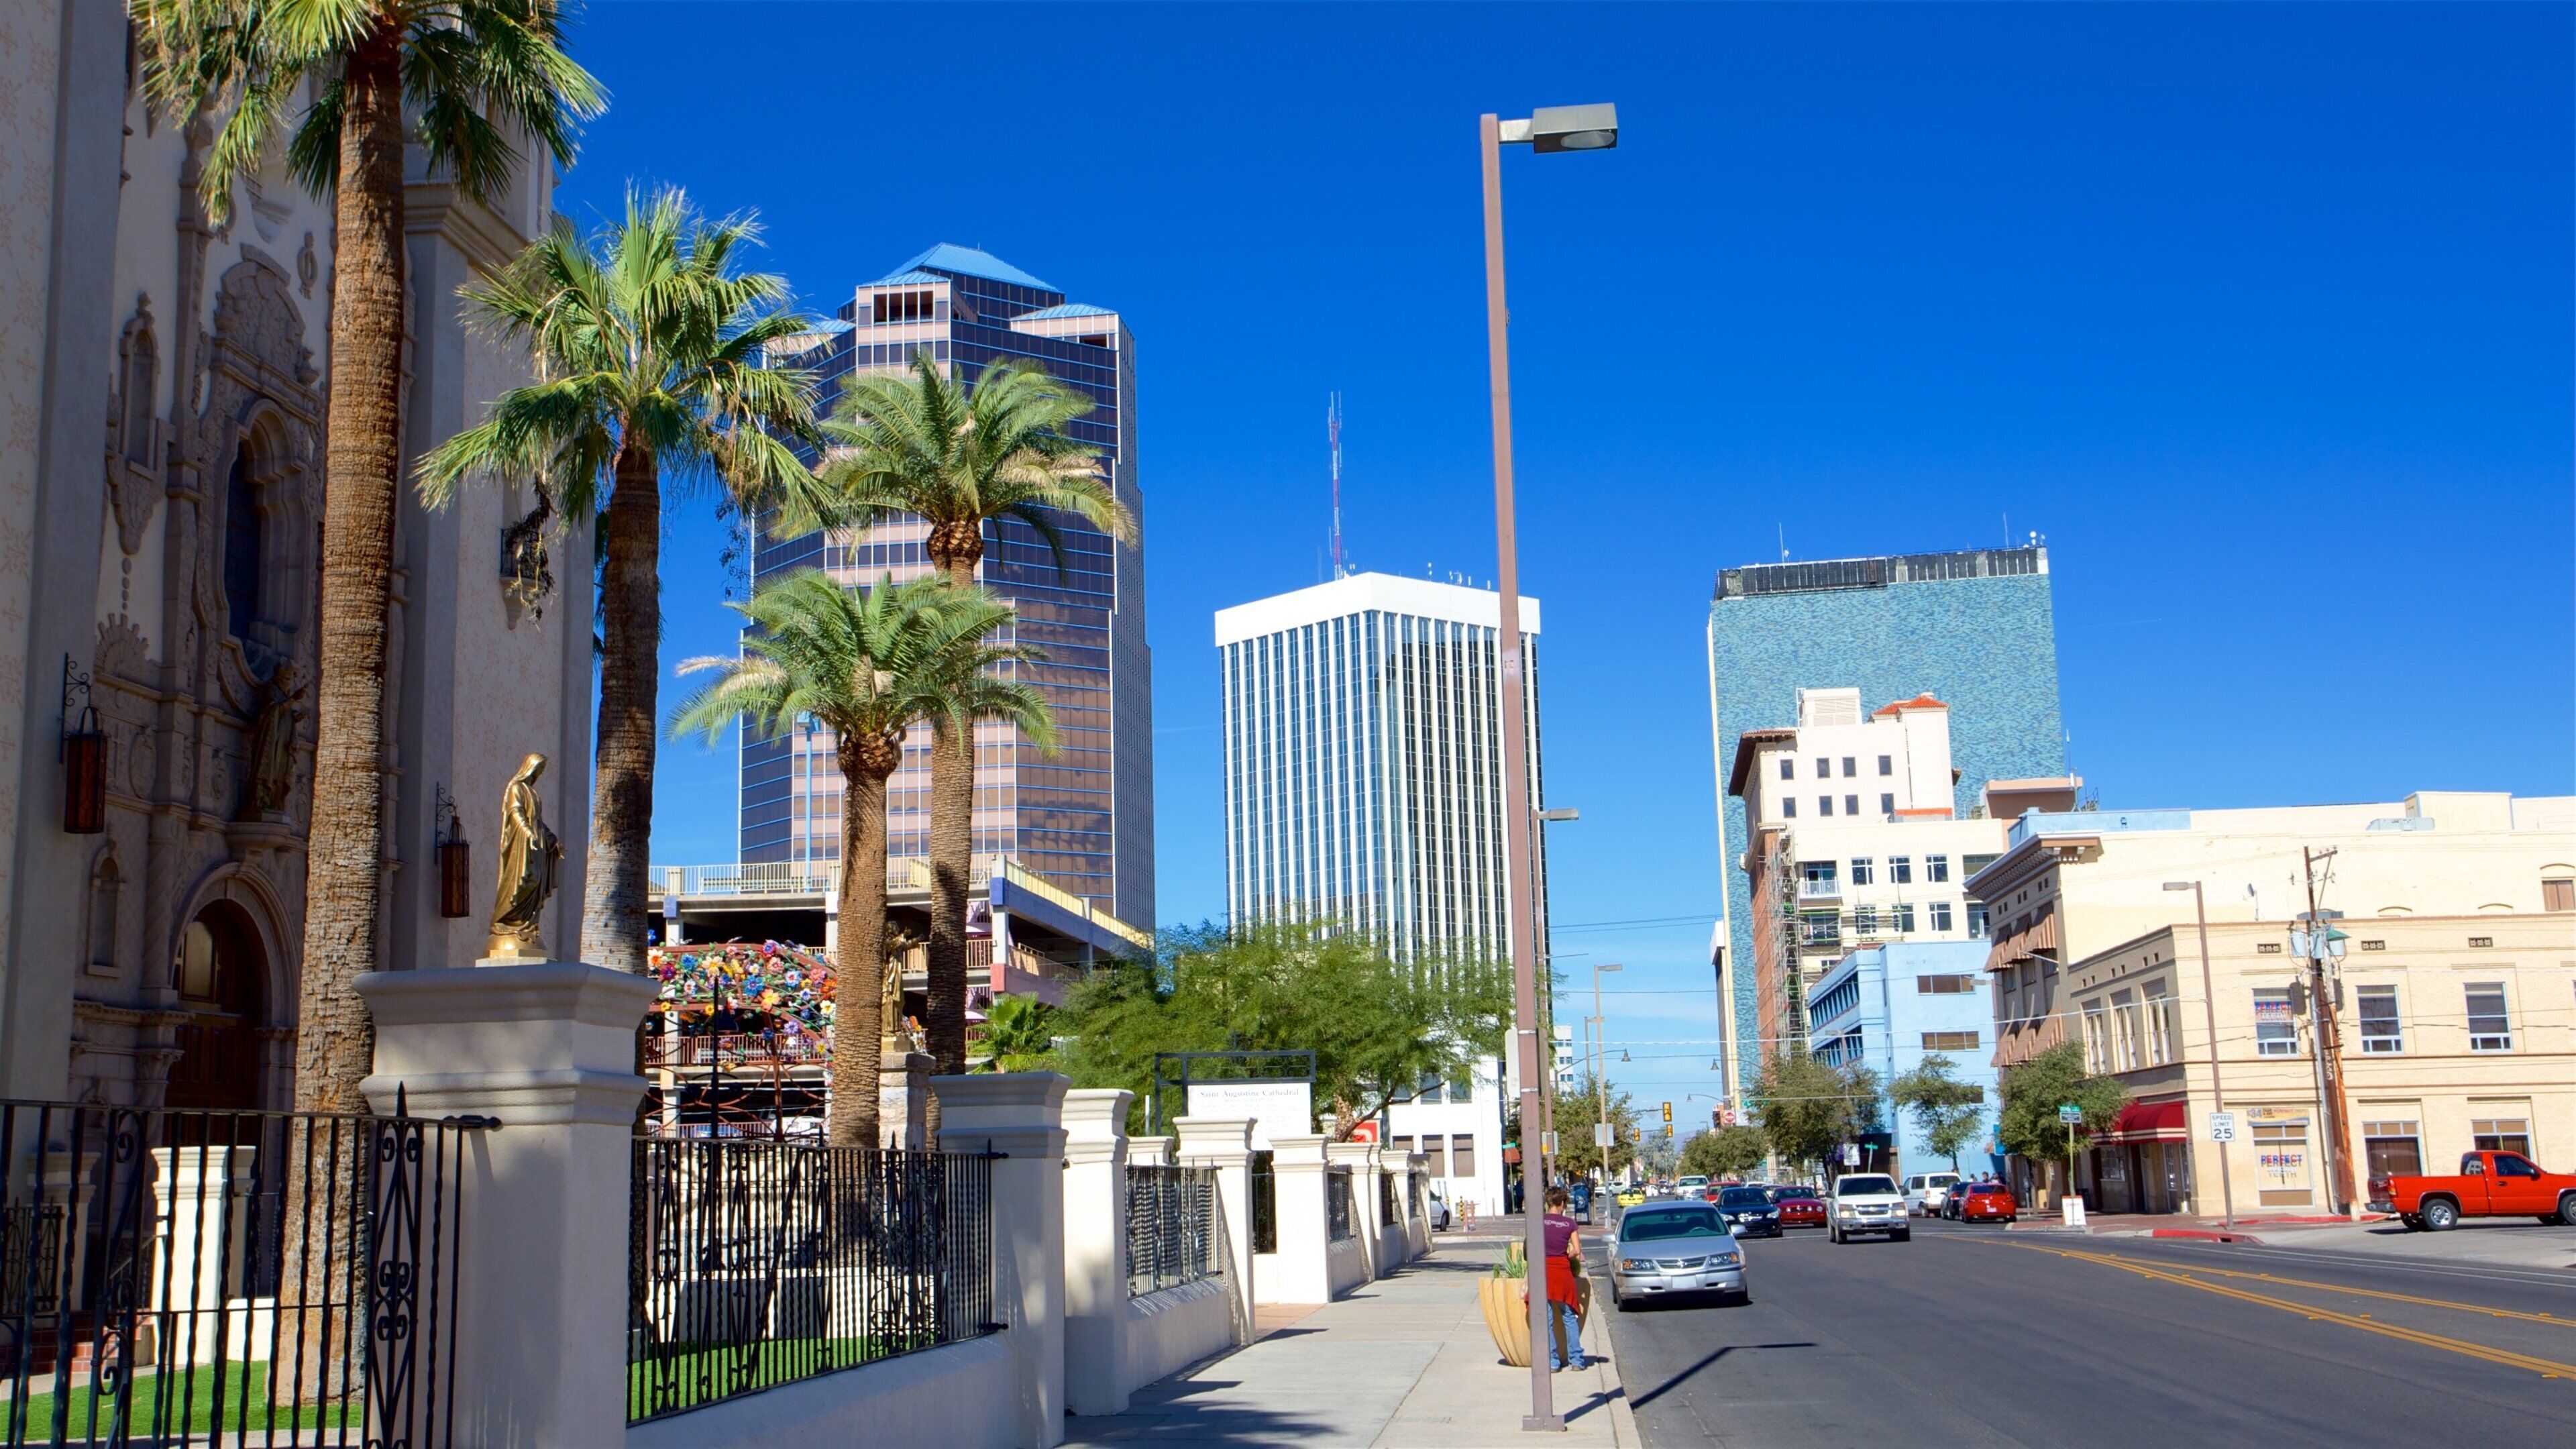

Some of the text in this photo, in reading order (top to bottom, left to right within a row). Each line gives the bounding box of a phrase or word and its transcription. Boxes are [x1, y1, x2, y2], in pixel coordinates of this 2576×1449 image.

[1200, 1088, 1299, 1098] Saint Augustine Cathedral
[2214, 1128, 2233, 1139] 25
[2261, 1154, 2302, 1166] PERFECT
